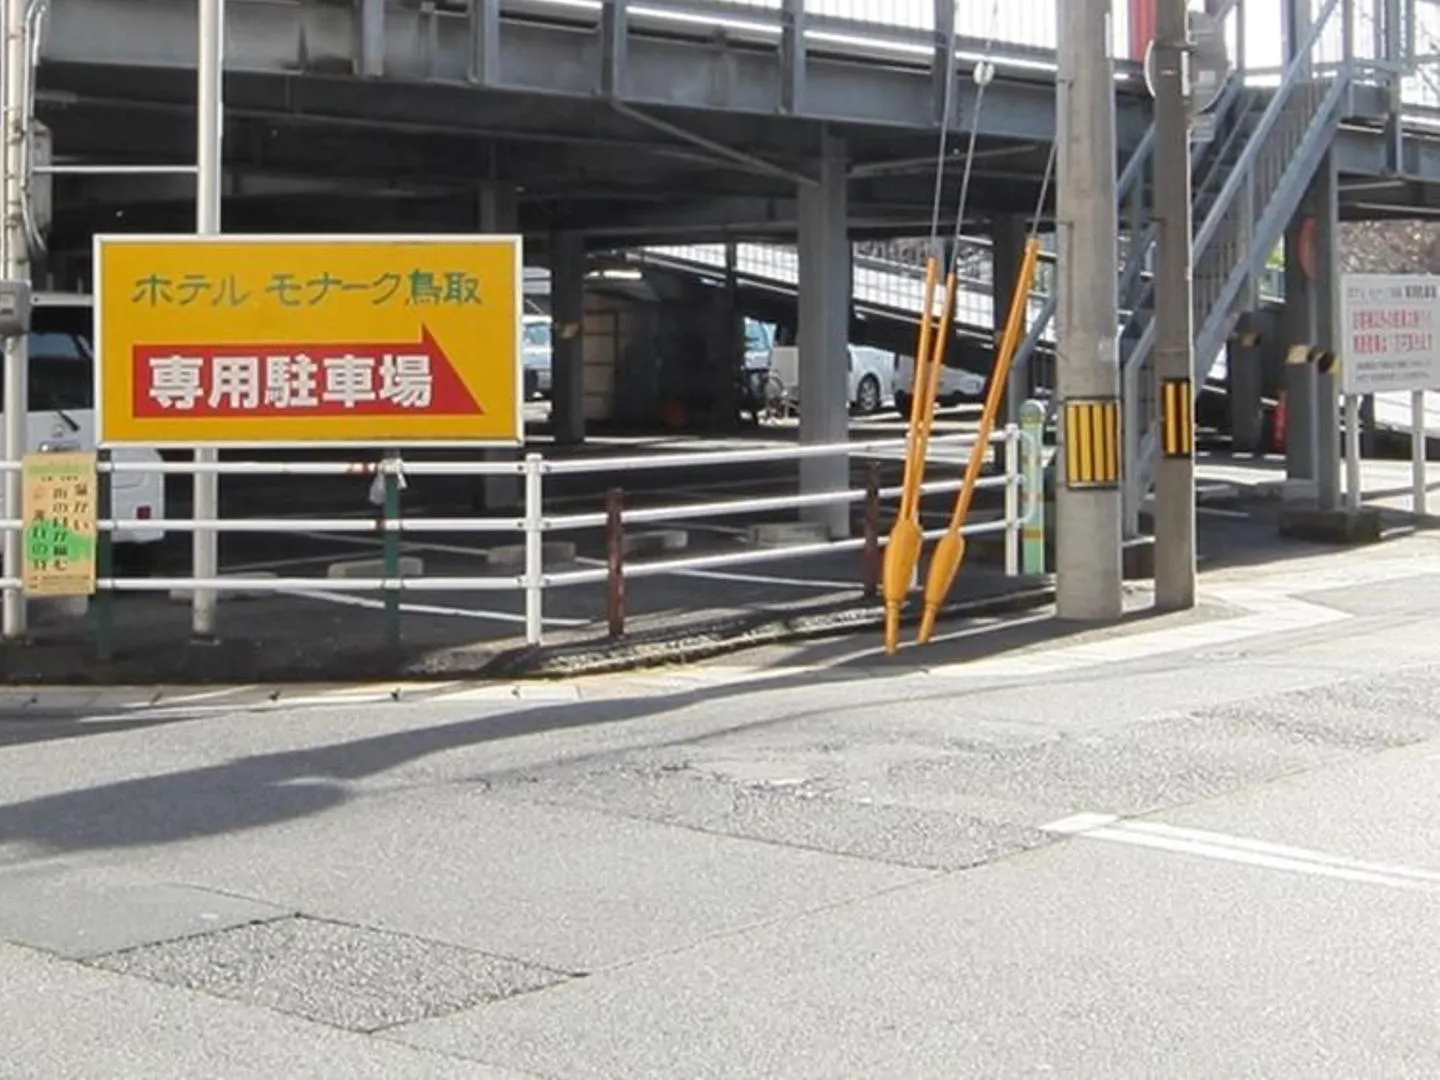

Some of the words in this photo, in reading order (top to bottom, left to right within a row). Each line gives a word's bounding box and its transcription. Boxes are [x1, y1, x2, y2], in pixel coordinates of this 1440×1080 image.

[131, 272, 252, 307] ホテル
[265, 269, 484, 307] モナーク鳥取
[148, 354, 434, 409] 専用駐車場
